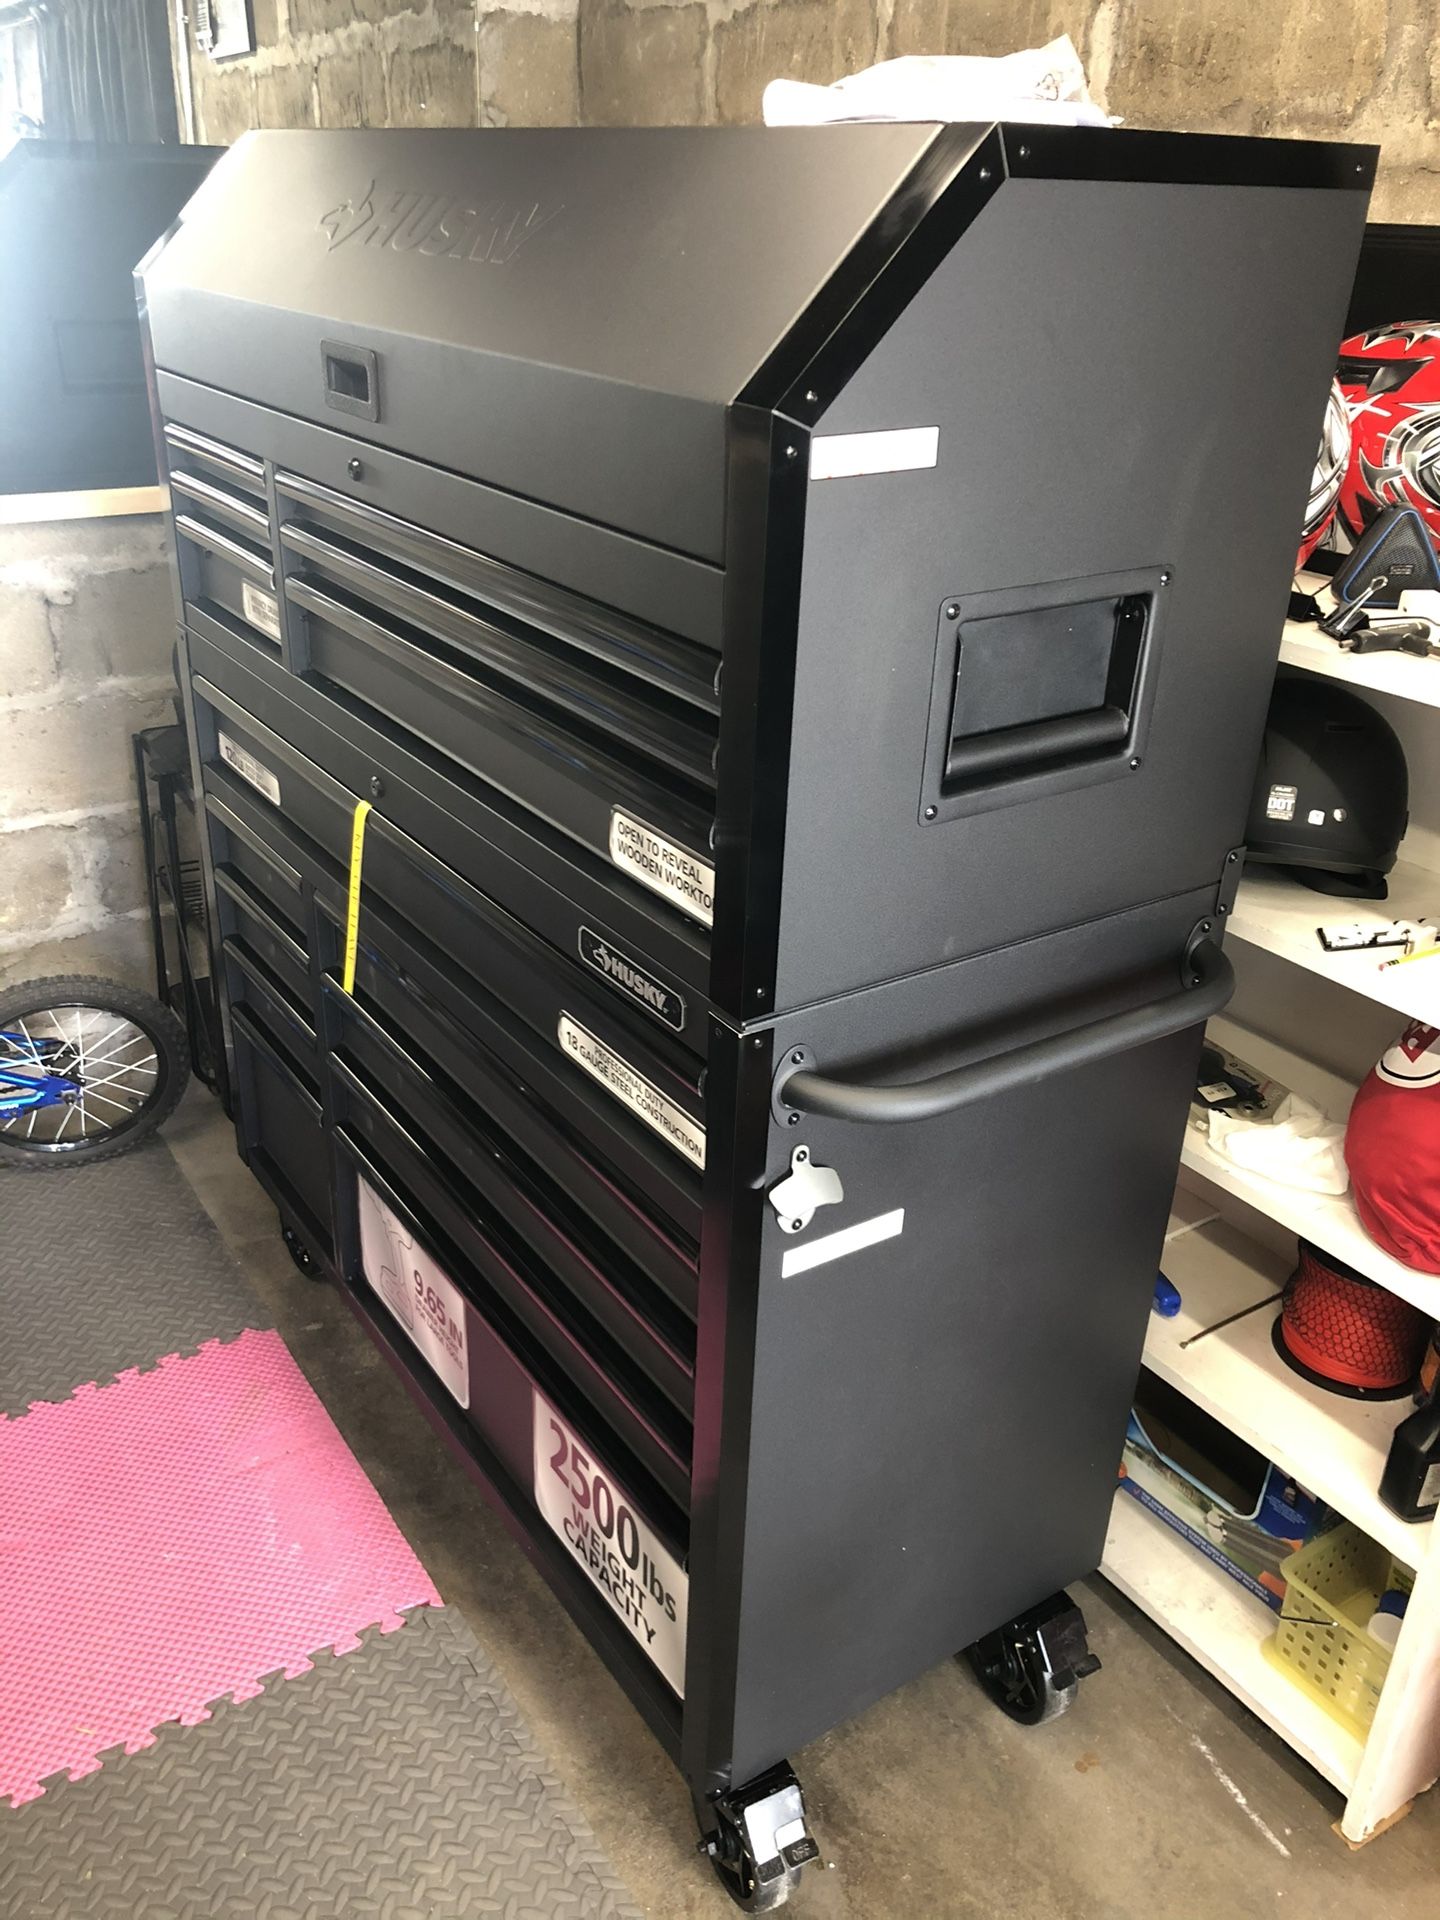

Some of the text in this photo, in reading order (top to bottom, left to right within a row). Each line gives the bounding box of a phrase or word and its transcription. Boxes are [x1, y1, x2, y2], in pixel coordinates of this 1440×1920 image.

[1267, 797, 1296, 811] DOT
[617, 821, 702, 885] OPEN TO REVEAL
[617, 838, 663, 878] WOODEN
[611, 956, 667, 1011] HUSKY
[566, 1031, 702, 1158] 18 GAUGE STEEL CONSTRUCTION
[594, 1045, 665, 1110] PROFESSIONAL DUTY
[414, 1269, 463, 1350] 9.65 IN
[550, 1417, 677, 1623] 2500 lbs
[563, 1516, 657, 1646] CAPACITY
[571, 1501, 647, 1609] WEIGHT
[791, 1843, 812, 1862] OFF
